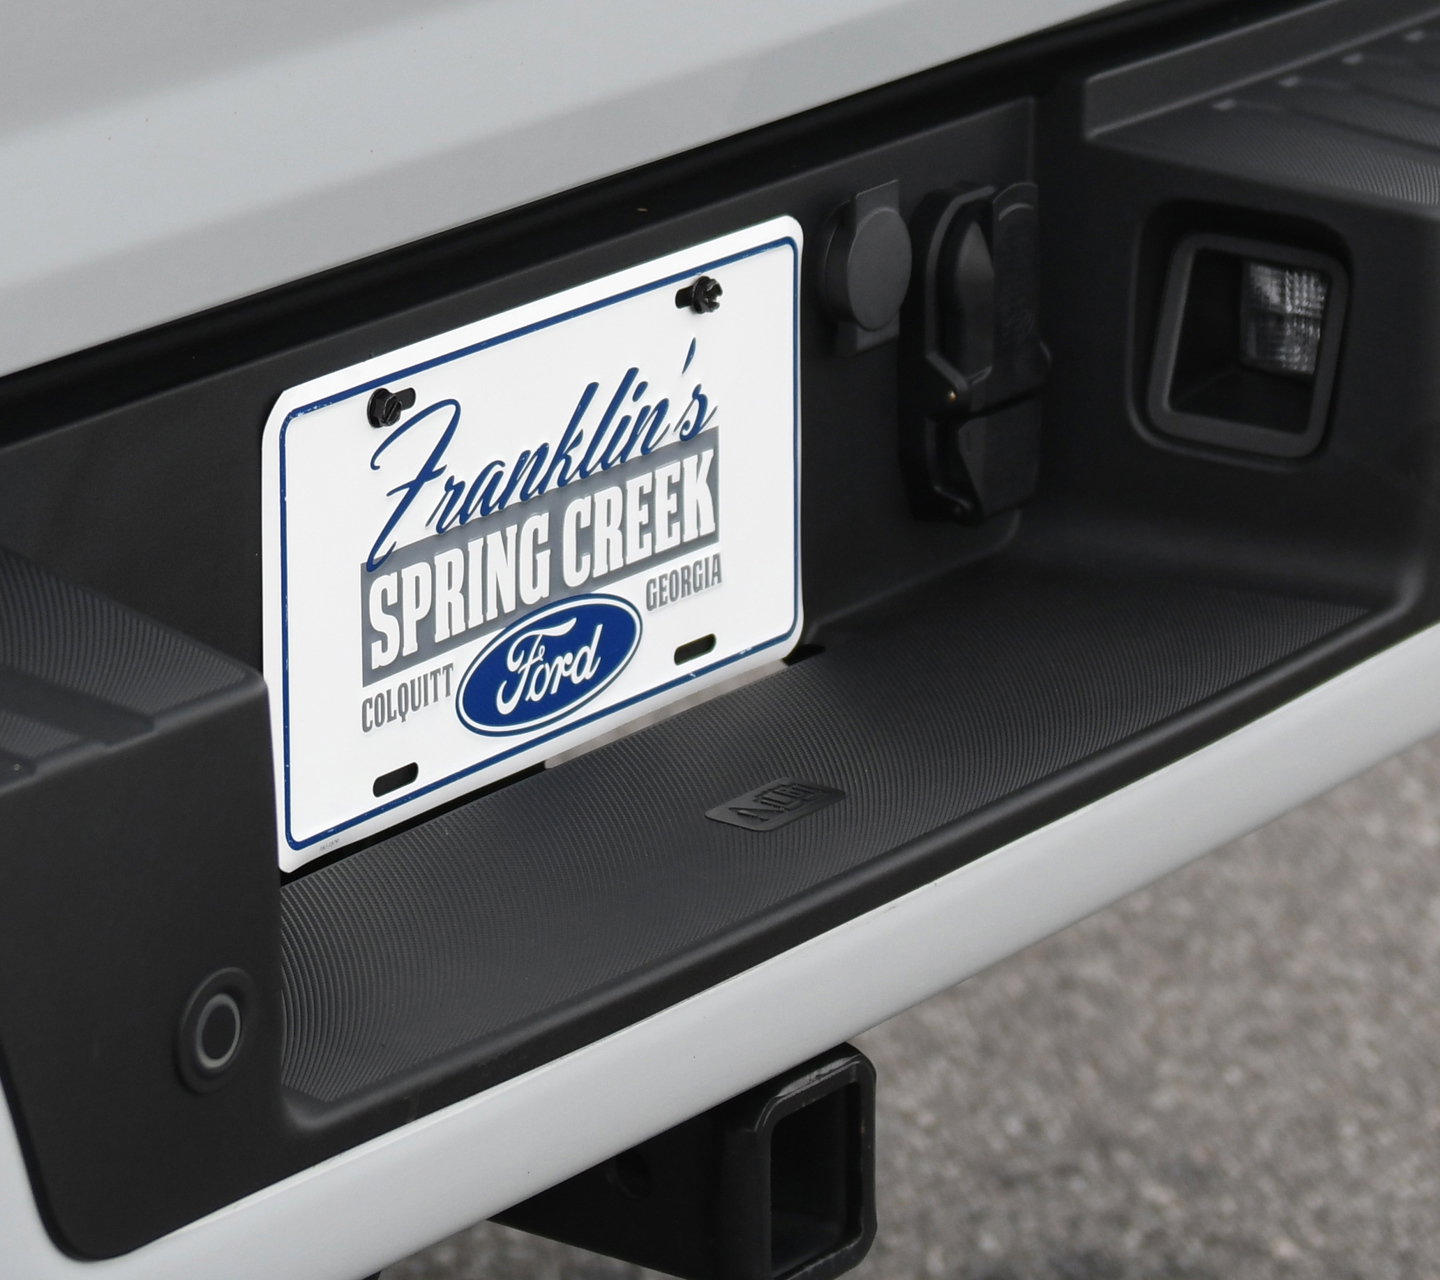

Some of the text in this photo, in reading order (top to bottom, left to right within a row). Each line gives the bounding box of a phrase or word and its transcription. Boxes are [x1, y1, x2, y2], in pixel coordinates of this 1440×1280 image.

[367, 336, 718, 572] Franklin's
[369, 448, 717, 671] SPRING CREEK
[645, 551, 723, 613] GEORGIA
[361, 662, 455, 734] COLQUITT
[495, 616, 604, 716] Ford
